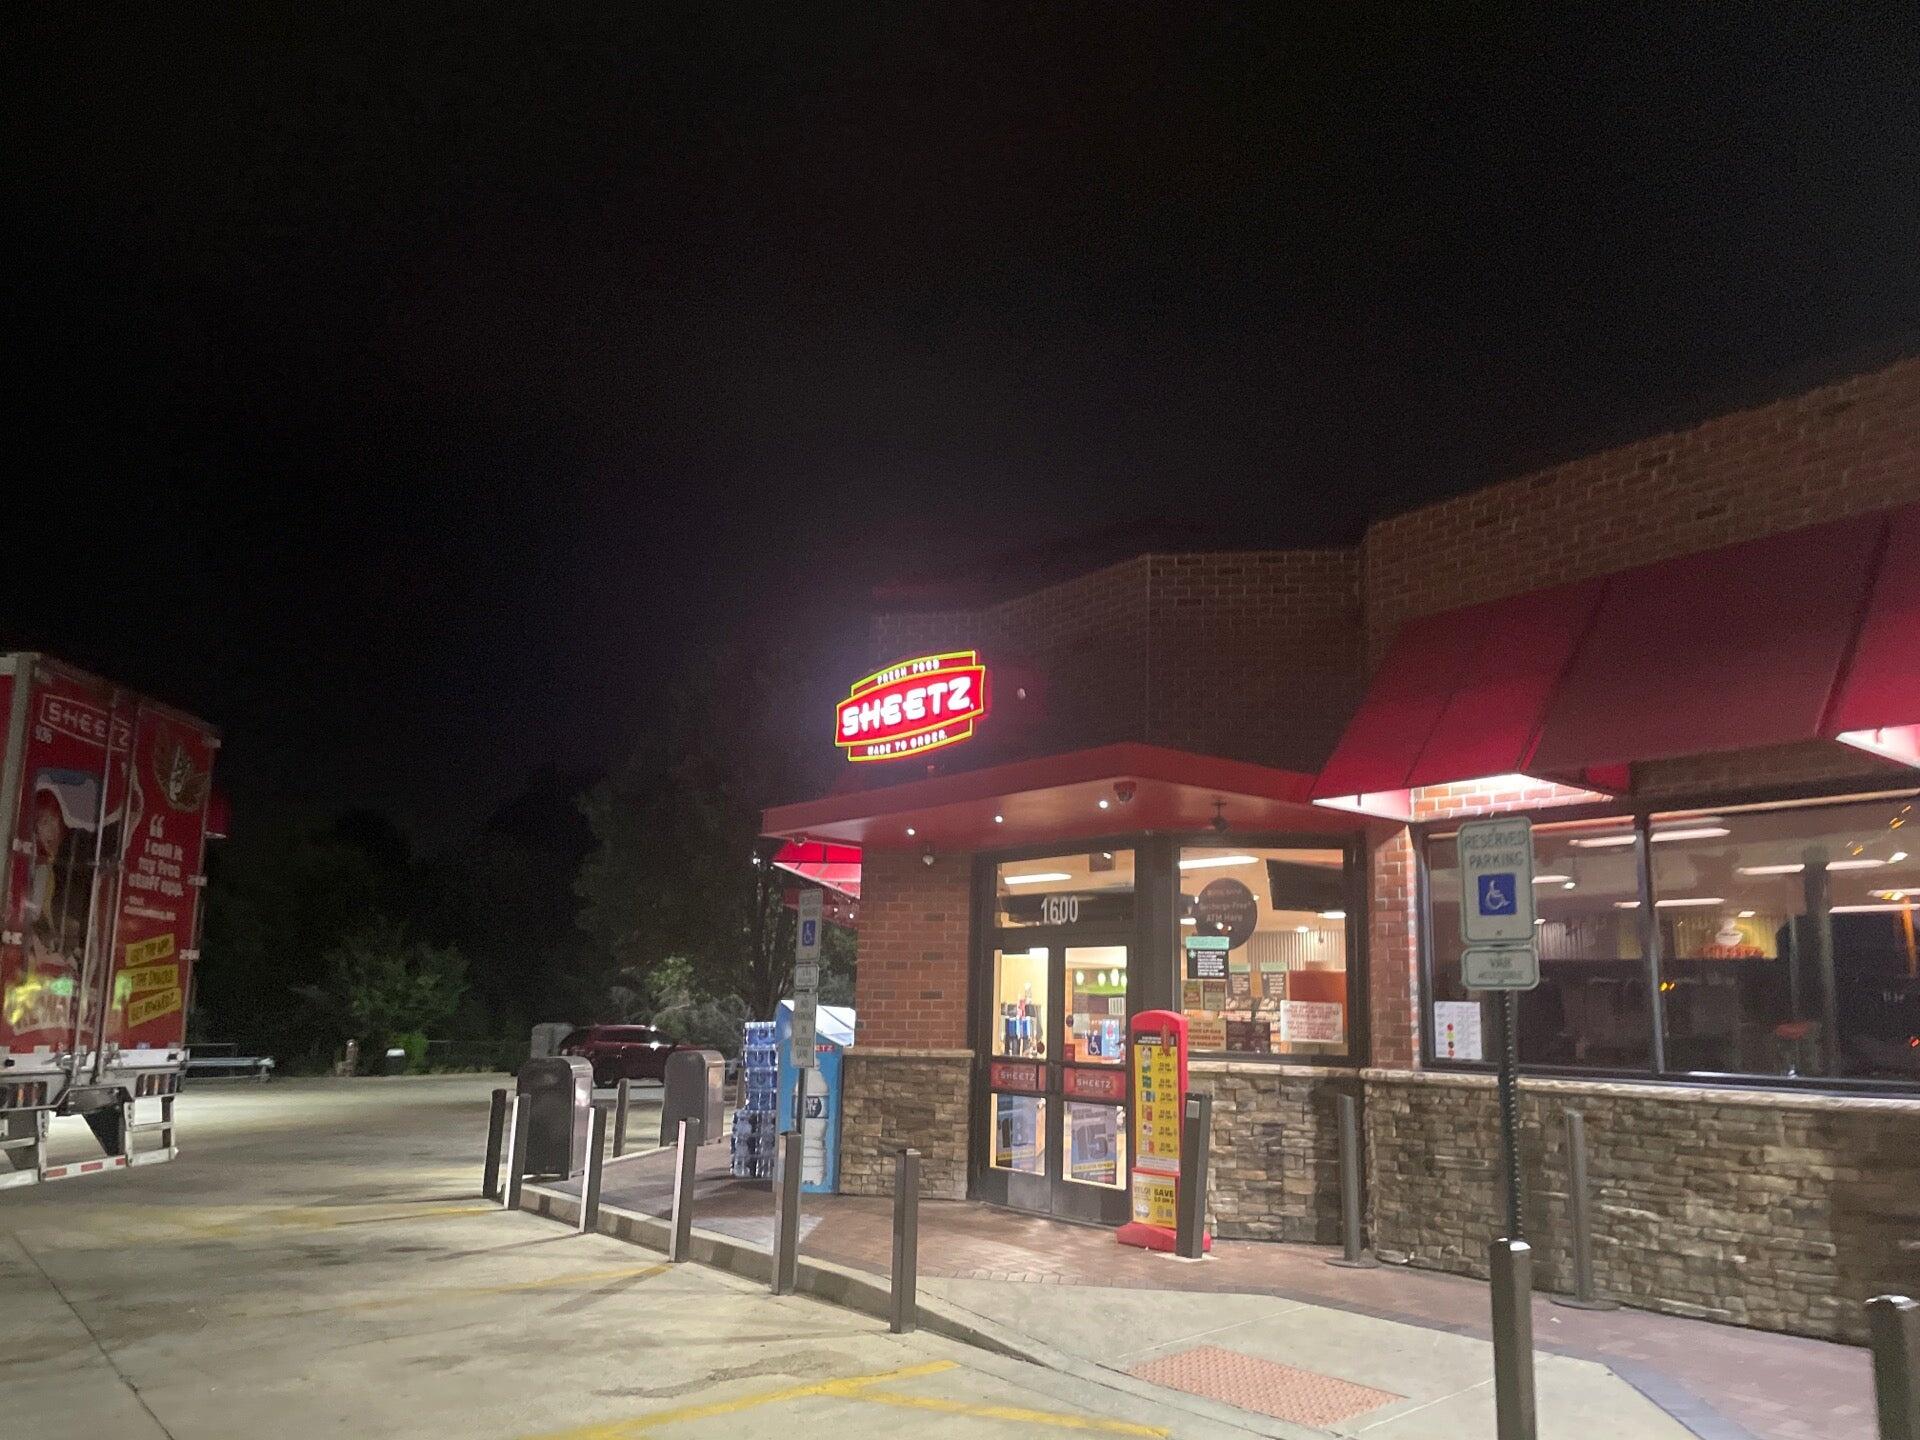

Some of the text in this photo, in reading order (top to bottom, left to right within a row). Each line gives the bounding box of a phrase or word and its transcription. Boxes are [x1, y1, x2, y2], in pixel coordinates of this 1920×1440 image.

[877, 659, 940, 685] FRESH FOOD
[842, 676, 971, 736] SHEETZ
[867, 743, 891, 755] MADE
[895, 740, 907, 751] TO
[1464, 831, 1527, 849] RESERVED
[1469, 851, 1524, 868] PARKING
[1041, 895, 1078, 923] 1600
[1000, 1072, 1036, 1081] SHEETZ
[1076, 1078, 1112, 1089] SHEETZ
[1154, 1188, 1174, 1198] SAVE
